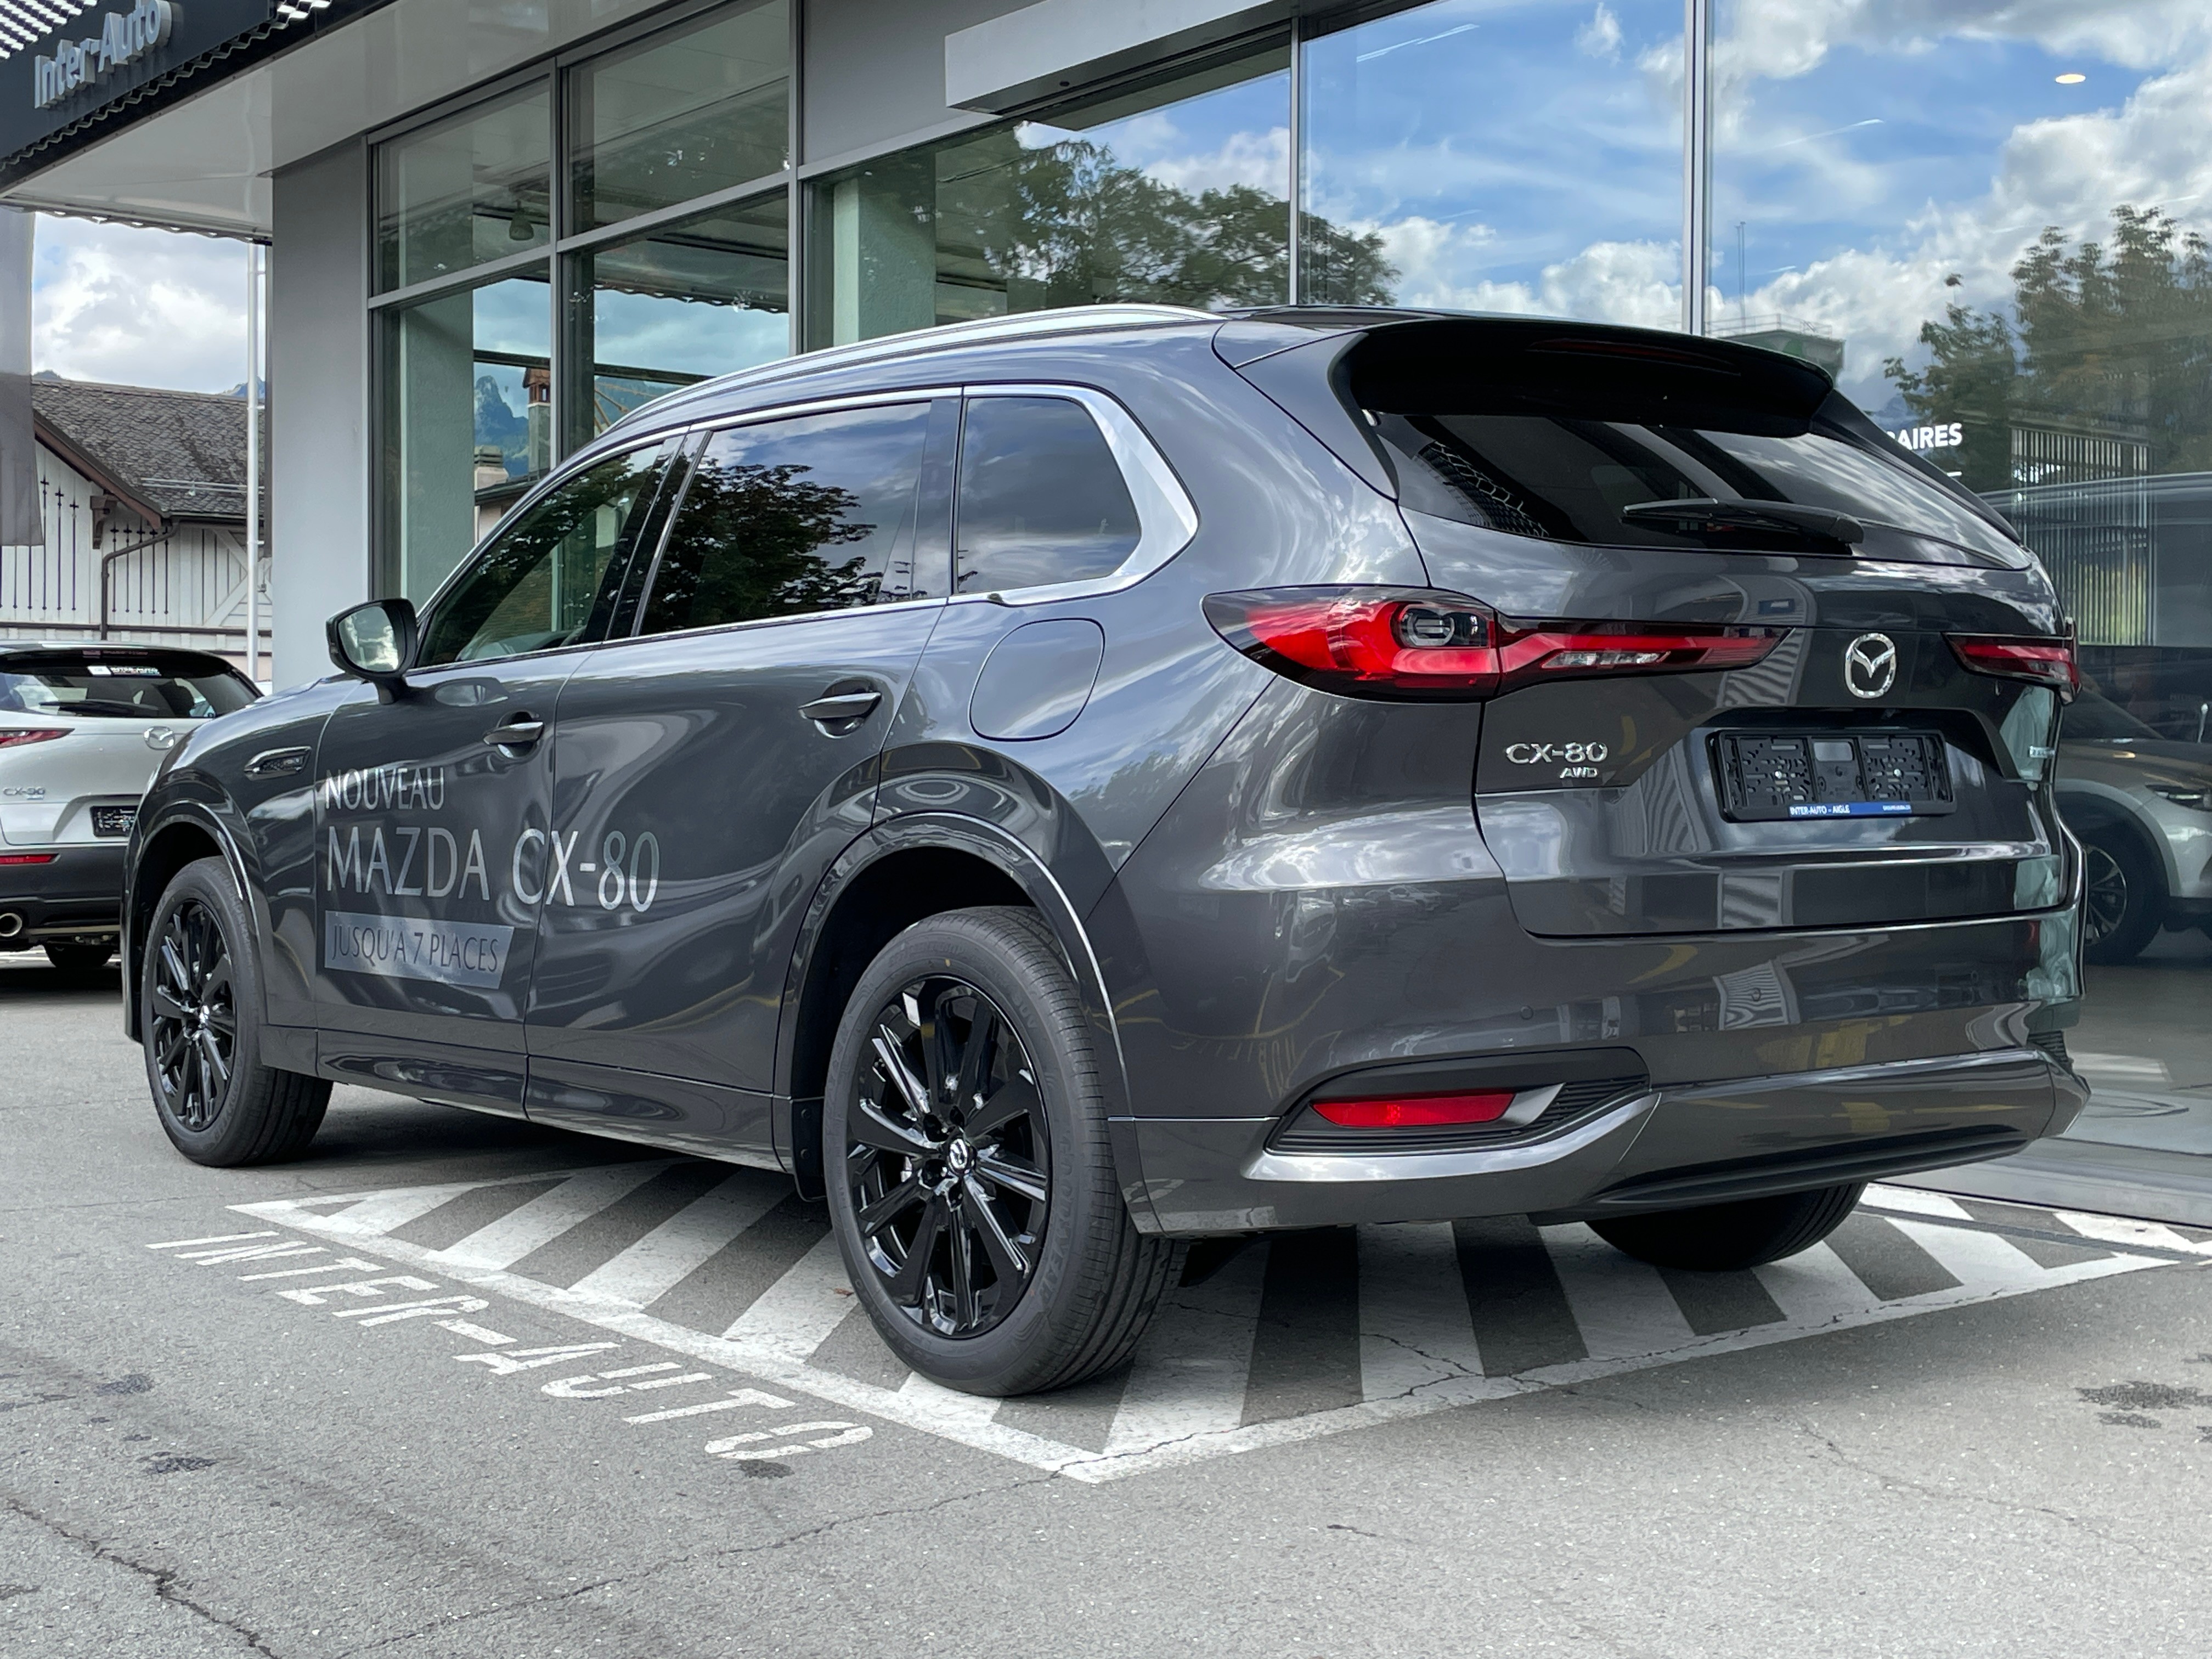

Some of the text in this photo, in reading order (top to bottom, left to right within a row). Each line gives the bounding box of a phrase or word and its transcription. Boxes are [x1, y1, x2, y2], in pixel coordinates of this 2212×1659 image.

[35, 0, 172, 109] Inter-Auto
[1887, 422, 1963, 450] AIRES
[1506, 742, 1607, 764] CX-80
[1560, 767, 1598, 778] AWD
[325, 767, 445, 810] NOUVEAU
[1833, 805, 1850, 814] AIGLE
[328, 826, 659, 912] MAZDA CX-80
[332, 925, 498, 973] JUSQU'A 7 PLACES
[145, 1231, 874, 1460] INTER-AUTO
